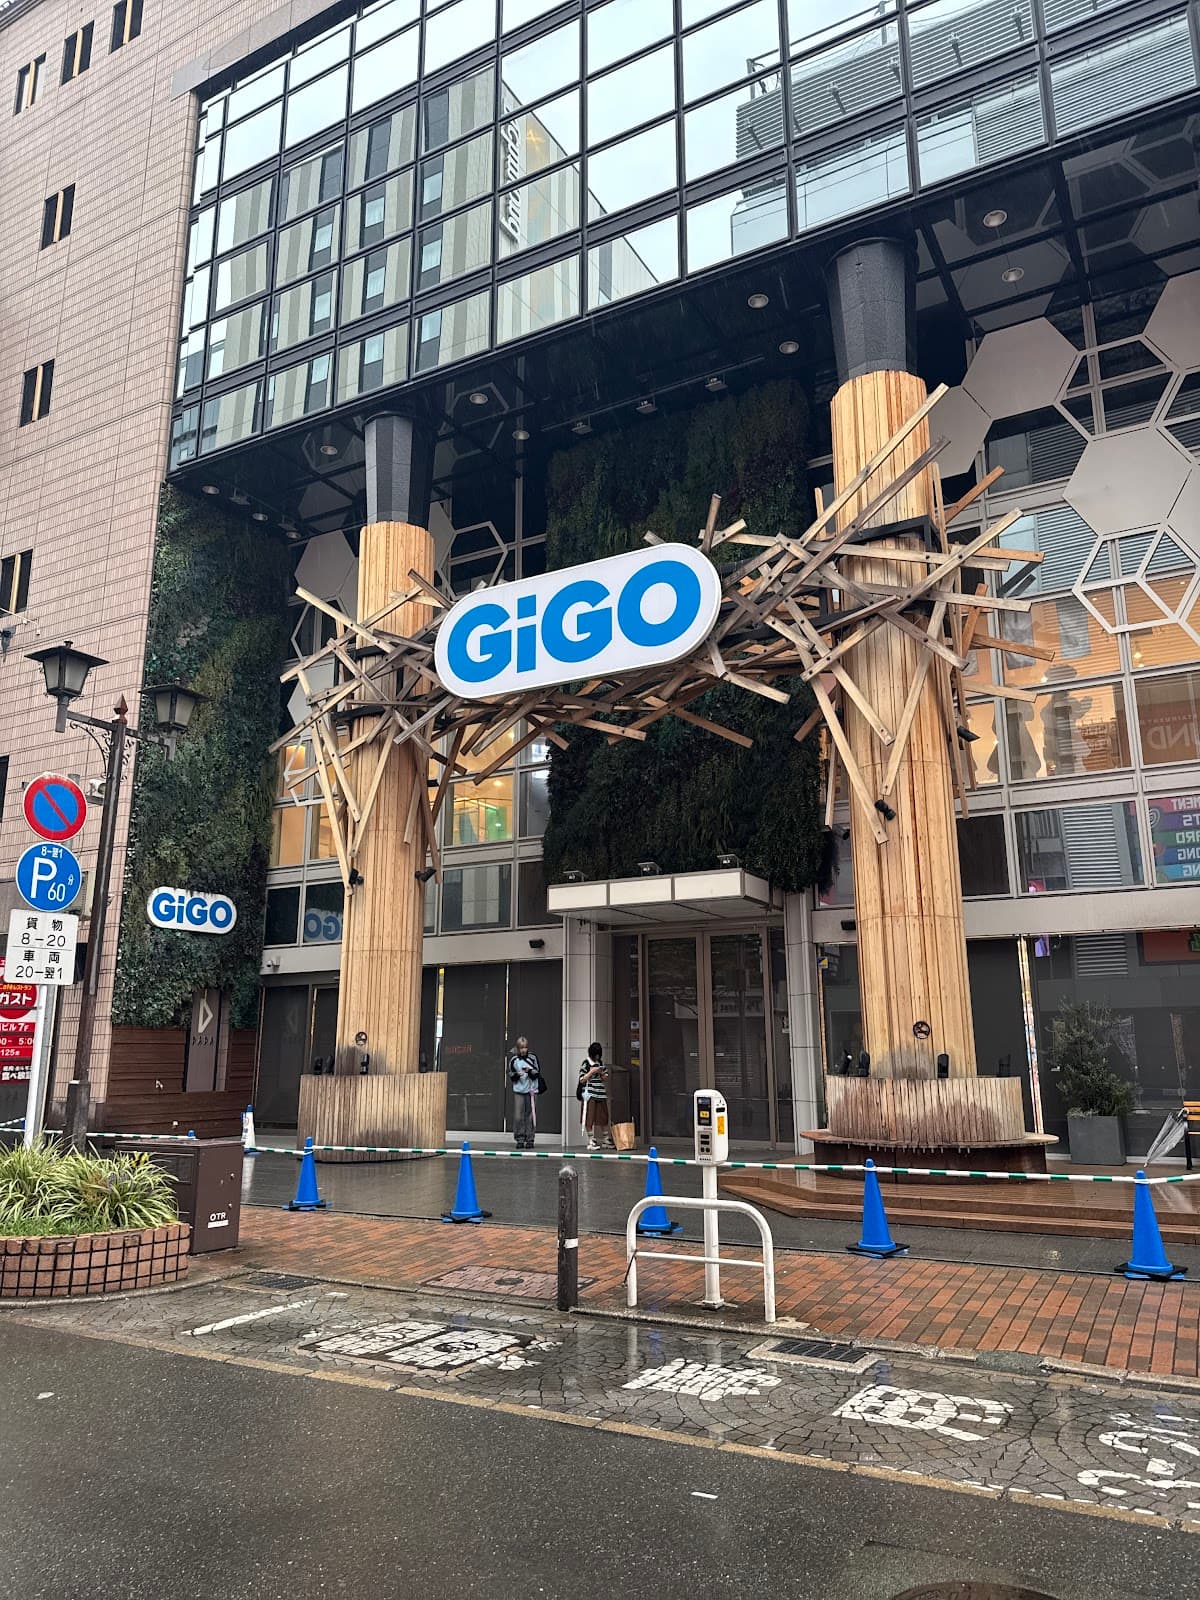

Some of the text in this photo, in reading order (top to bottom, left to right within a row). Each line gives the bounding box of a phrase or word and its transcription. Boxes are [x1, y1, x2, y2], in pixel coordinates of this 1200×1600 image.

[447, 560, 702, 683] GiGO
[30, 857, 58, 899] P
[47, 882, 66, 902] 60
[152, 892, 232, 928] GiGO
[209, 1211, 227, 1221] OTR
